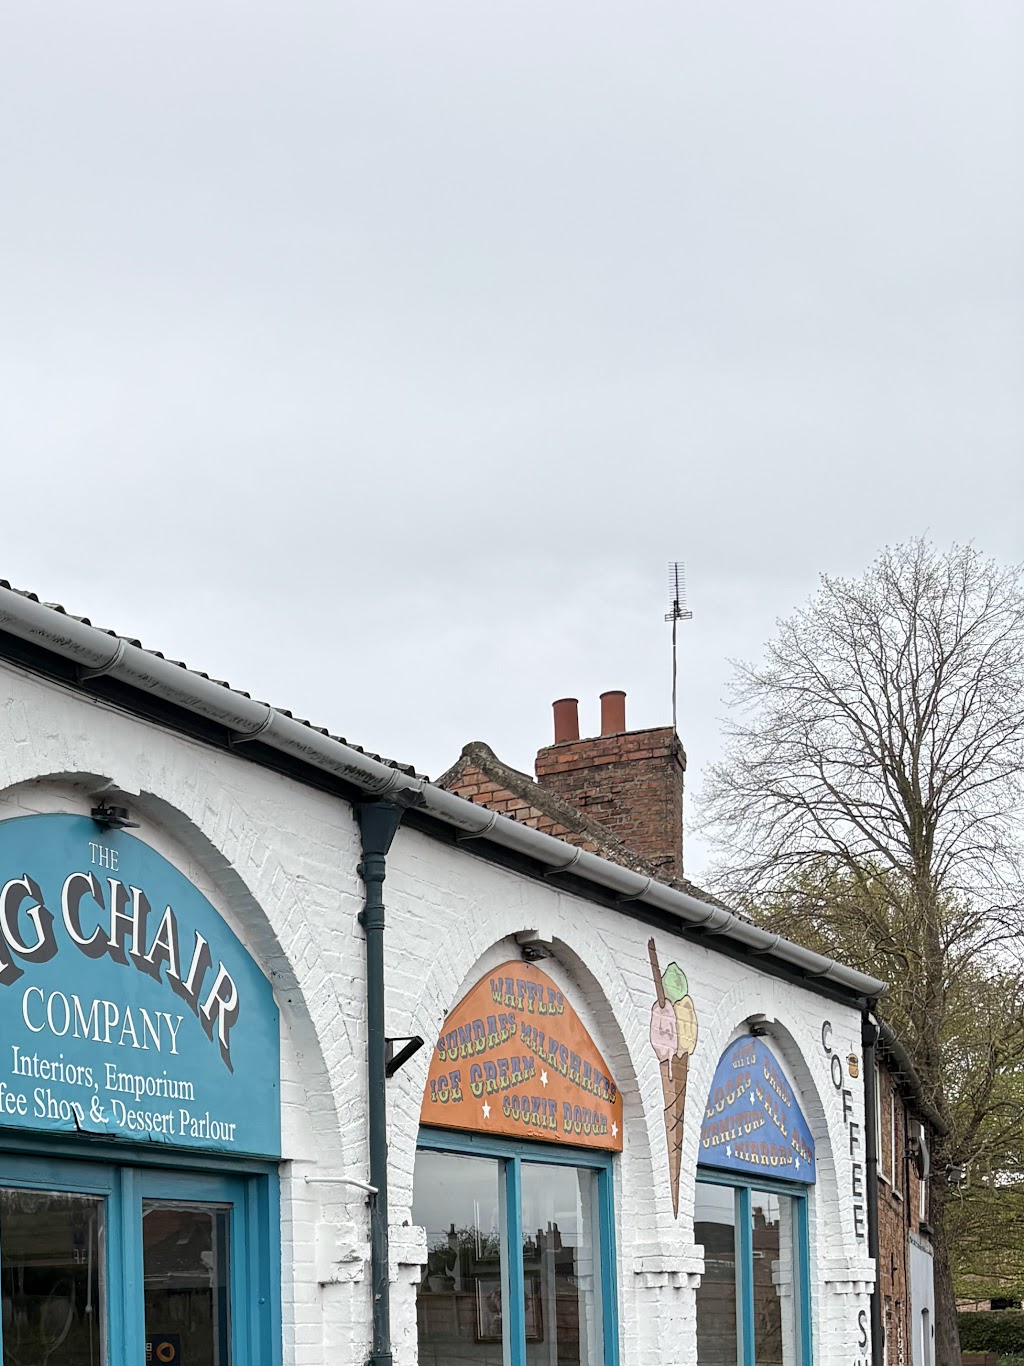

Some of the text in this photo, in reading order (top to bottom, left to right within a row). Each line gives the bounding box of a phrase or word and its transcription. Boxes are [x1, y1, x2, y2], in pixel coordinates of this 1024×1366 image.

[88, 841, 119, 871] THE
[60, 871, 240, 1074] CHAIR
[490, 977, 565, 1016] WAFFLES
[22, 986, 184, 1055] COMPANY
[11, 1045, 195, 1102] Interiors, Emporium
[429, 1055, 537, 1104] ICE CREAM
[437, 1012, 617, 1104] SUNDAES MILKSHAKES
[33, 1087, 85, 1129] Shop
[89, 1095, 109, 1123] &
[110, 1098, 175, 1135] Dessert
[178, 1108, 236, 1141] Parlour
[502, 1095, 608, 1136] COOKIE DOUGH
[705, 1071, 751, 1118] LOCKS
[701, 1110, 765, 1149] URNITURE
[734, 1140, 793, 1167] MIRRORS
[821, 1020, 865, 1239] COFFEE
